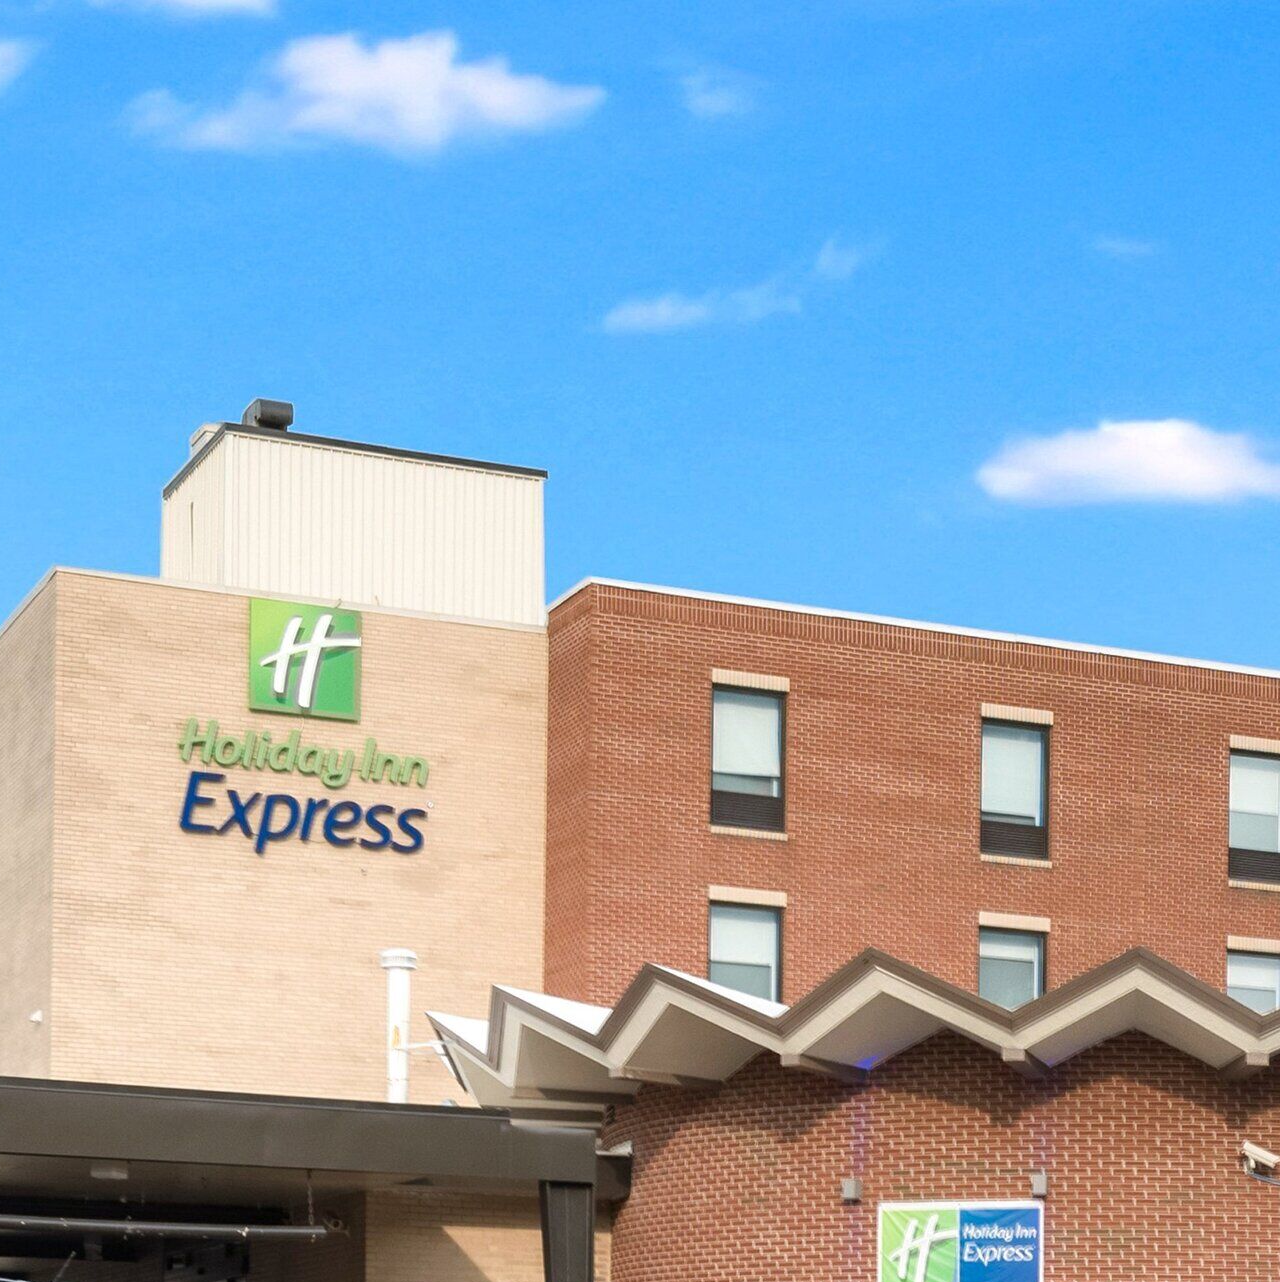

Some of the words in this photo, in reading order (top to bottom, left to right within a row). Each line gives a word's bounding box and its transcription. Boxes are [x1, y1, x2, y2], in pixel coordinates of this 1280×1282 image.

[178, 717, 354, 789] Holiday
[360, 738, 430, 788] Inn
[180, 771, 428, 855] Express
[963, 1223, 1014, 1242] Holiday
[1015, 1222, 1037, 1239] Inn
[963, 1241, 1034, 1267] Express
